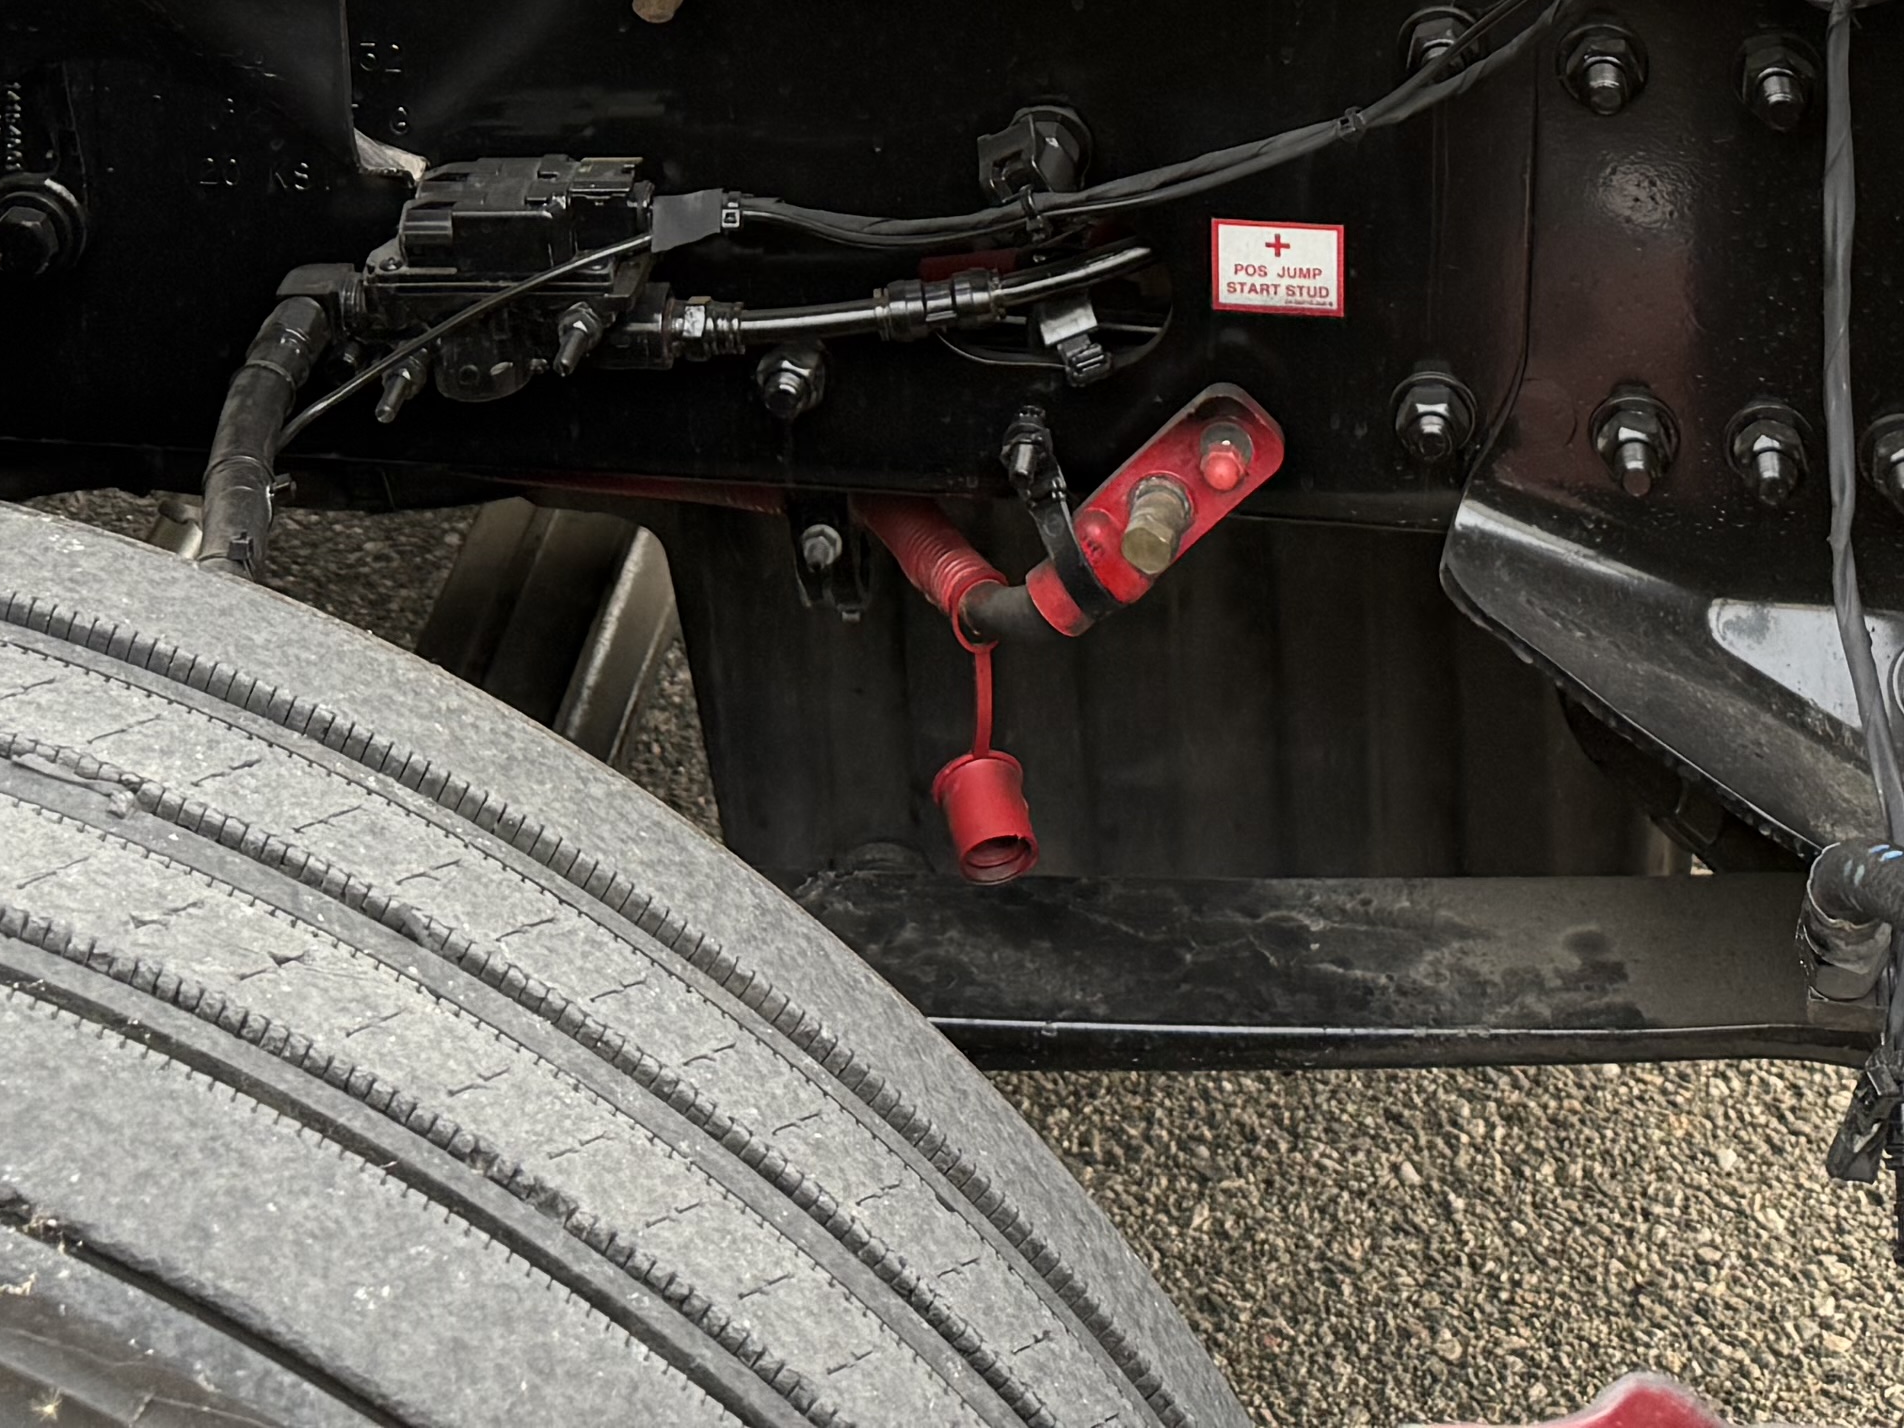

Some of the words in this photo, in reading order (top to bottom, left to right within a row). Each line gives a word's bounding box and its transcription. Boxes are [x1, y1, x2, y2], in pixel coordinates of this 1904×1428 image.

[1234, 263, 1268, 277] POS
[1277, 266, 1322, 280] JUMP
[1226, 281, 1280, 296] START
[1285, 284, 1330, 299] STUD
